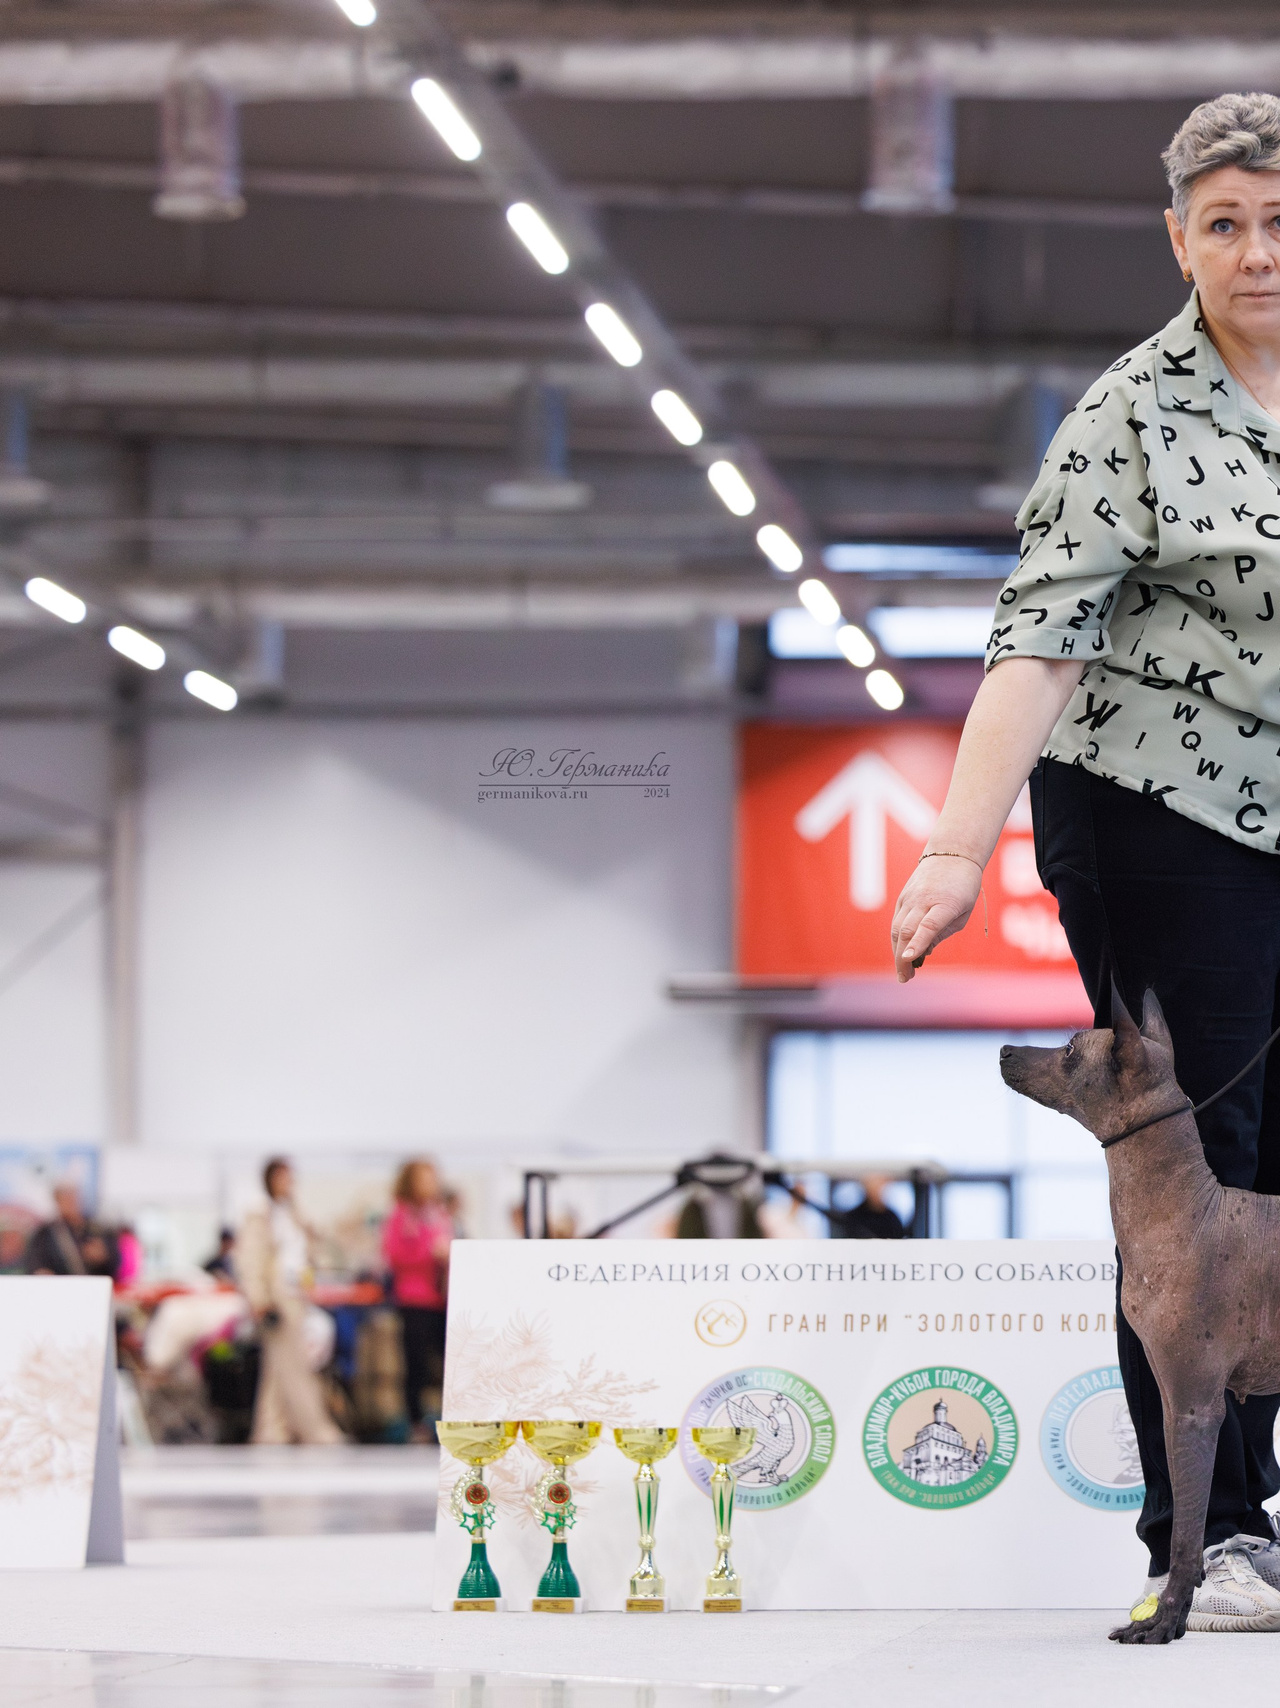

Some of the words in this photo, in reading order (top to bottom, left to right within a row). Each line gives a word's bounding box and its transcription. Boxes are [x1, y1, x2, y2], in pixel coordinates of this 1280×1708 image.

[1163, 346, 1196, 376] K
[1128, 371, 1151, 386] W
[1160, 425, 1177, 451] P
[1073, 455, 1091, 474] Q
[1104, 447, 1129, 475] K
[1186, 456, 1205, 486] J
[1224, 459, 1247, 477] H
[1093, 497, 1120, 528] R
[1162, 505, 1181, 523] Q
[1231, 503, 1255, 522] K
[1190, 516, 1214, 533] W
[1056, 531, 1082, 560] X
[1122, 545, 1153, 563] L
[1234, 555, 1256, 583] P
[1000, 588, 1017, 605] O
[1196, 579, 1215, 597] O
[1019, 608, 1047, 625] J
[1067, 599, 1096, 630] M
[1256, 592, 1274, 621] J
[1061, 637, 1075, 654] H
[1238, 648, 1262, 665] W
[1143, 653, 1165, 676] K
[1185, 661, 1226, 700] K
[1173, 702, 1200, 724] W
[1238, 717, 1264, 738] J
[1086, 741, 1099, 762] Q
[1181, 731, 1201, 752] Q
[1197, 758, 1224, 781] W
[1239, 776, 1260, 798] K
[1236, 803, 1268, 833] C
[547, 1263, 730, 1285] ФЕДЕРАЦИЯ
[741, 1262, 965, 1283] ОХОТНИЧЬЕГО
[768, 1313, 827, 1333] ГРАН
[843, 1313, 889, 1333] ПРИ
[754, 1370, 832, 1423] СУЗДАЛЬСКИЙ
[811, 1424, 833, 1464] СОКОЛ
[865, 1394, 896, 1469] ВЛАДИМИР
[889, 1370, 932, 1401] КУБОК
[935, 1369, 987, 1398] ГОРОДА
[981, 1389, 1017, 1467] ВЛАДИМИРА
